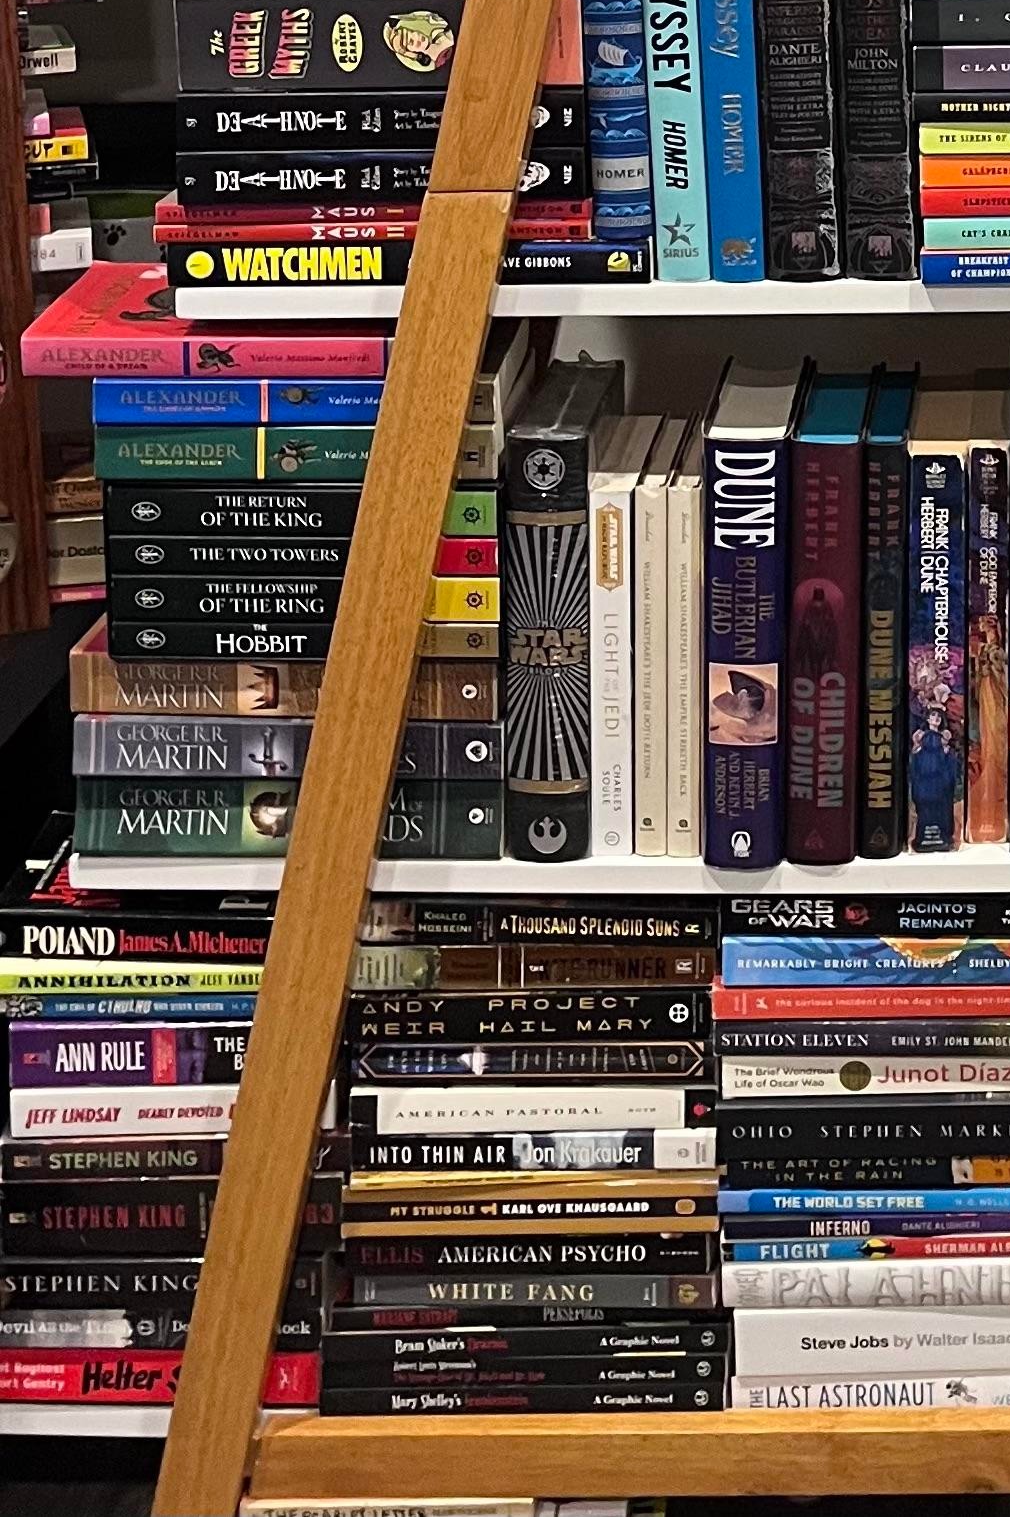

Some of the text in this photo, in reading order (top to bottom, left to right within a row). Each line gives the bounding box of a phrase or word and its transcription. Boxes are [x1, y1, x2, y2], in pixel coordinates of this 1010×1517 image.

[662, 119, 689, 190] HOMER
[222, 247, 382, 281] WATCHMEN
[713, 449, 776, 550] DUNE
[201, 511, 323, 528] OF THE KING
[190, 547, 339, 561] THE TWO TOWERS
[215, 634, 307, 654] HOBBIT
[117, 810, 229, 836] MARTIN
[23, 925, 115, 956] POLAND
[488, 996, 641, 1012] PROJECT
[480, 1019, 652, 1034] HAIL MARY
[721, 1034, 869, 1048] STATION ELEVEN
[56, 1041, 145, 1072] ANN RULE
[877, 1065, 950, 1084] Junot
[49, 1149, 198, 1170] STEPHEN KING
[370, 1145, 506, 1164] INTO THIN AIR
[438, 1245, 646, 1264] AMERICAN PSYCHO
[760, 1244, 830, 1259] FLIGHT
[427, 1284, 595, 1301] WHITE FANG
[801, 1335, 846, 1351] Steve
[850, 1334, 889, 1349] Jobs
[893, 1334, 914, 1350] by
[917, 1333, 968, 1347] Walter
[766, 1382, 934, 1407] LAST ASTRONAUT
